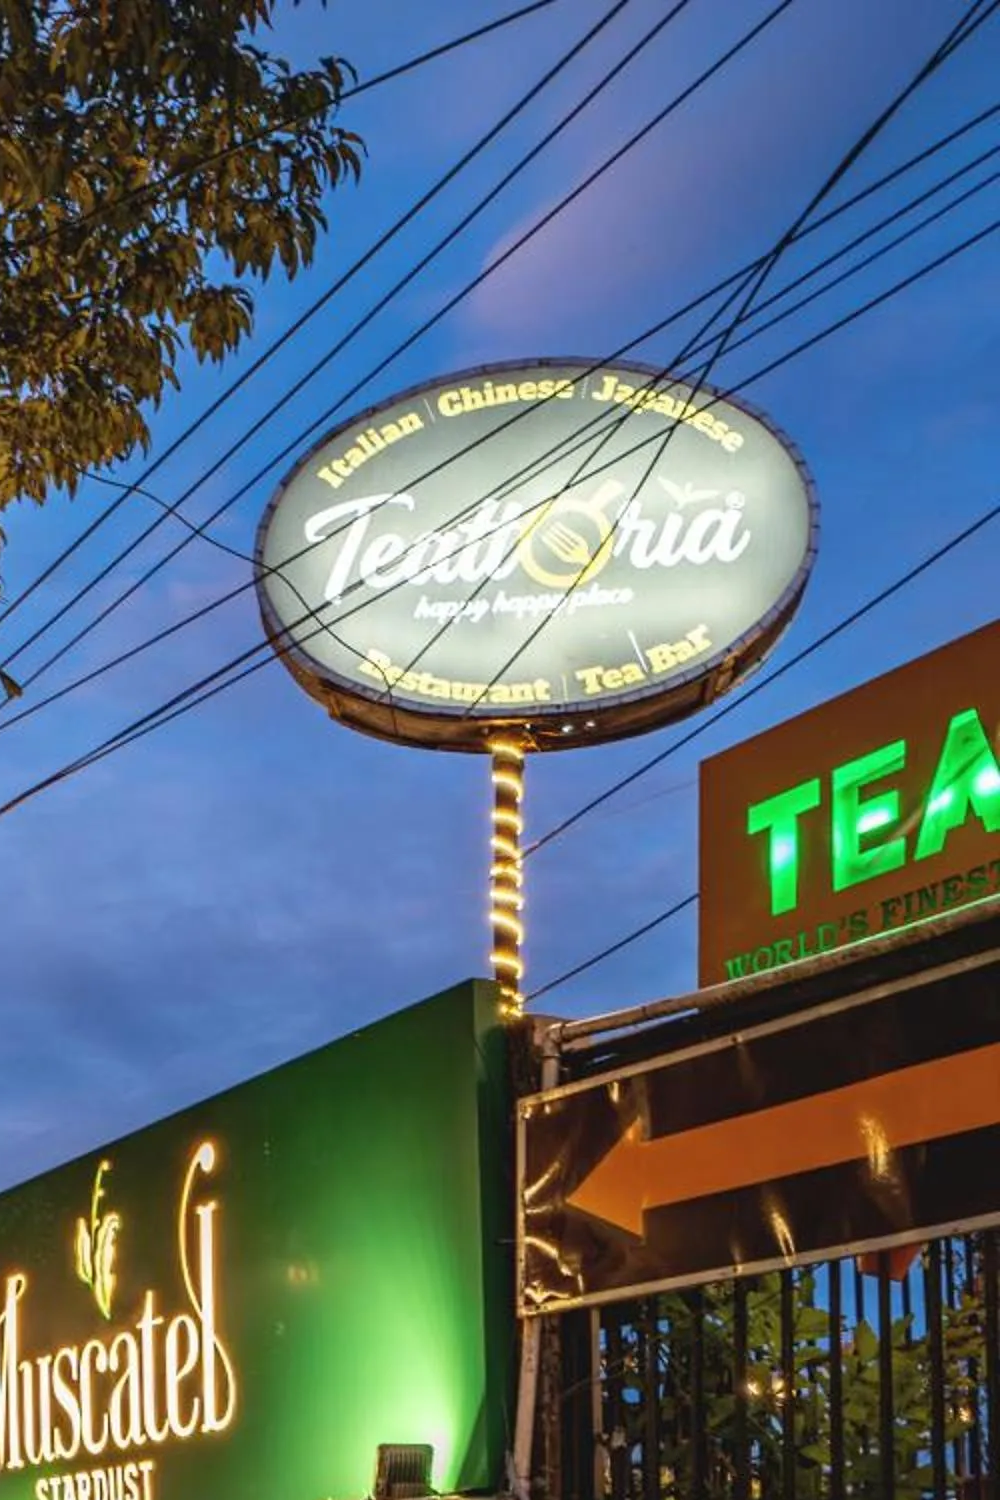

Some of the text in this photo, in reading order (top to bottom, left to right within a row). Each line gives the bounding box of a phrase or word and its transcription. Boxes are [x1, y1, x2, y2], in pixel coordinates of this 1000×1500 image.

[317, 375, 745, 488] Italian Chinese Japanese
[414, 595, 490, 624] happy
[358, 624, 713, 702] Restaurant Tea Bar
[747, 707, 1000, 916] TEA
[724, 908, 869, 981] WORLD'S
